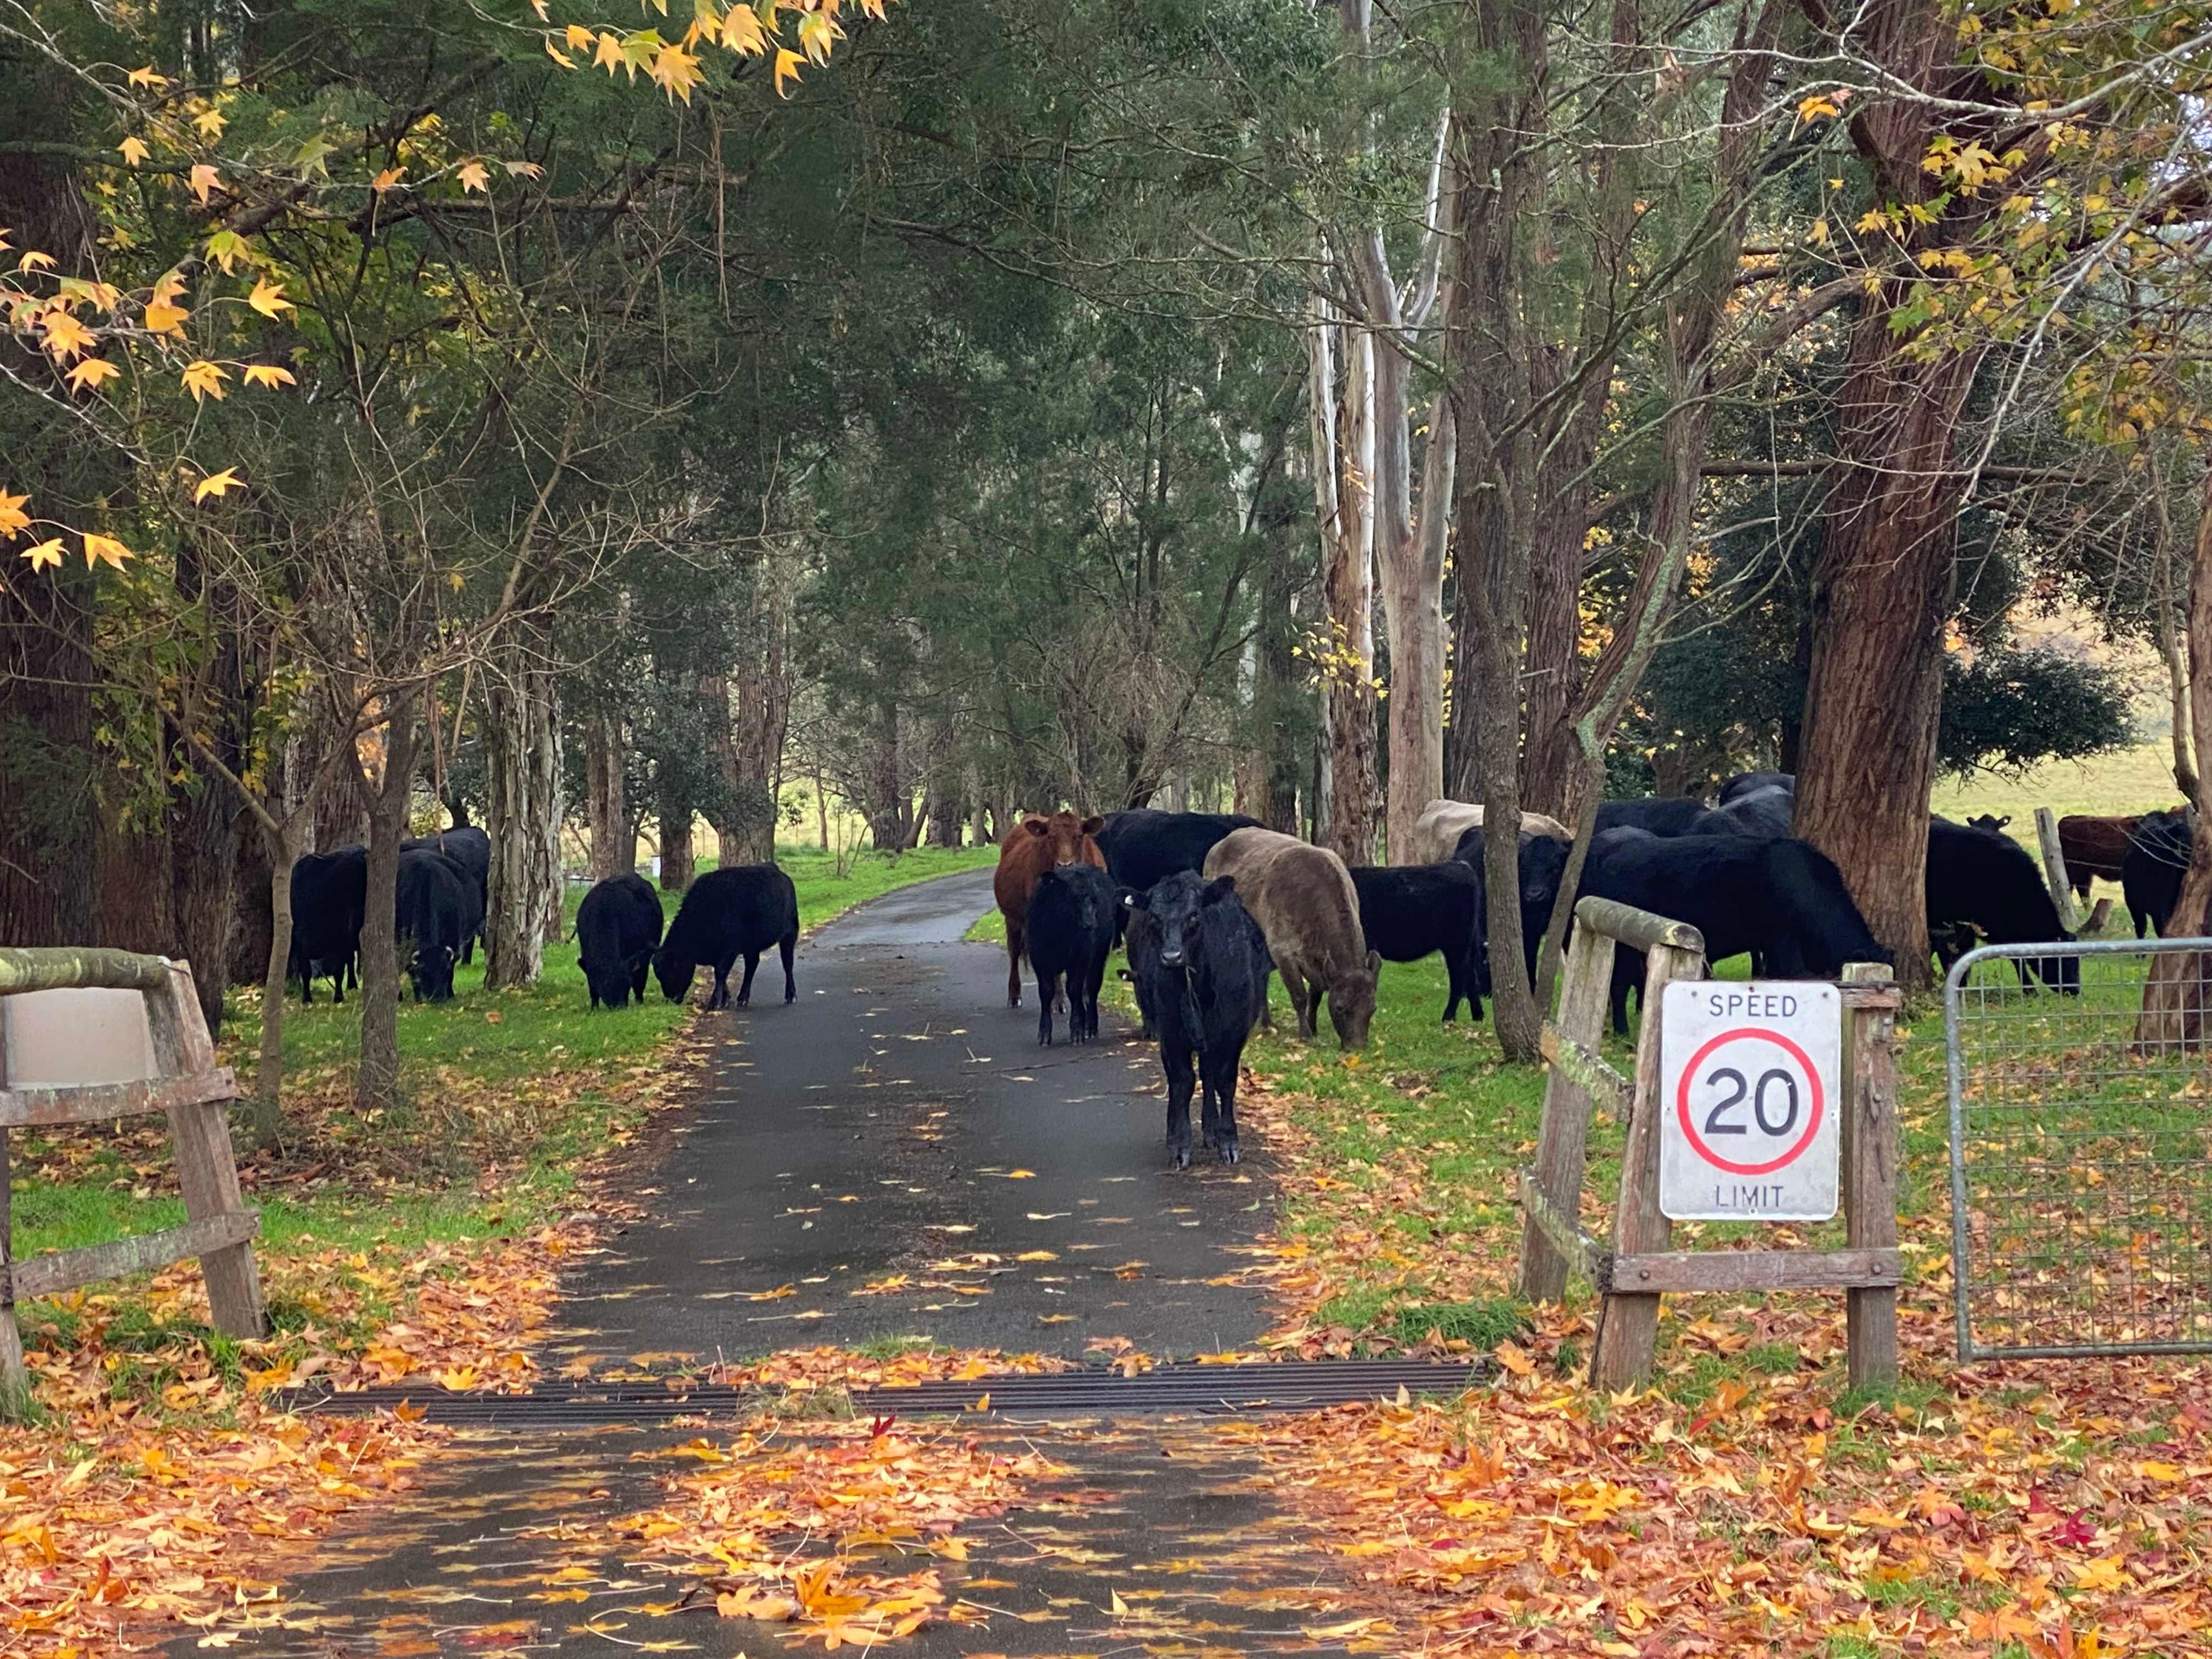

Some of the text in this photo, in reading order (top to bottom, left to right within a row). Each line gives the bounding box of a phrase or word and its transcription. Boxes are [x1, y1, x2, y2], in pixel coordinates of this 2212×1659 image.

[1709, 995, 1797, 1017] SPEED
[1705, 1068, 1798, 1136] 20
[1716, 1185, 1784, 1207] LIMIT
